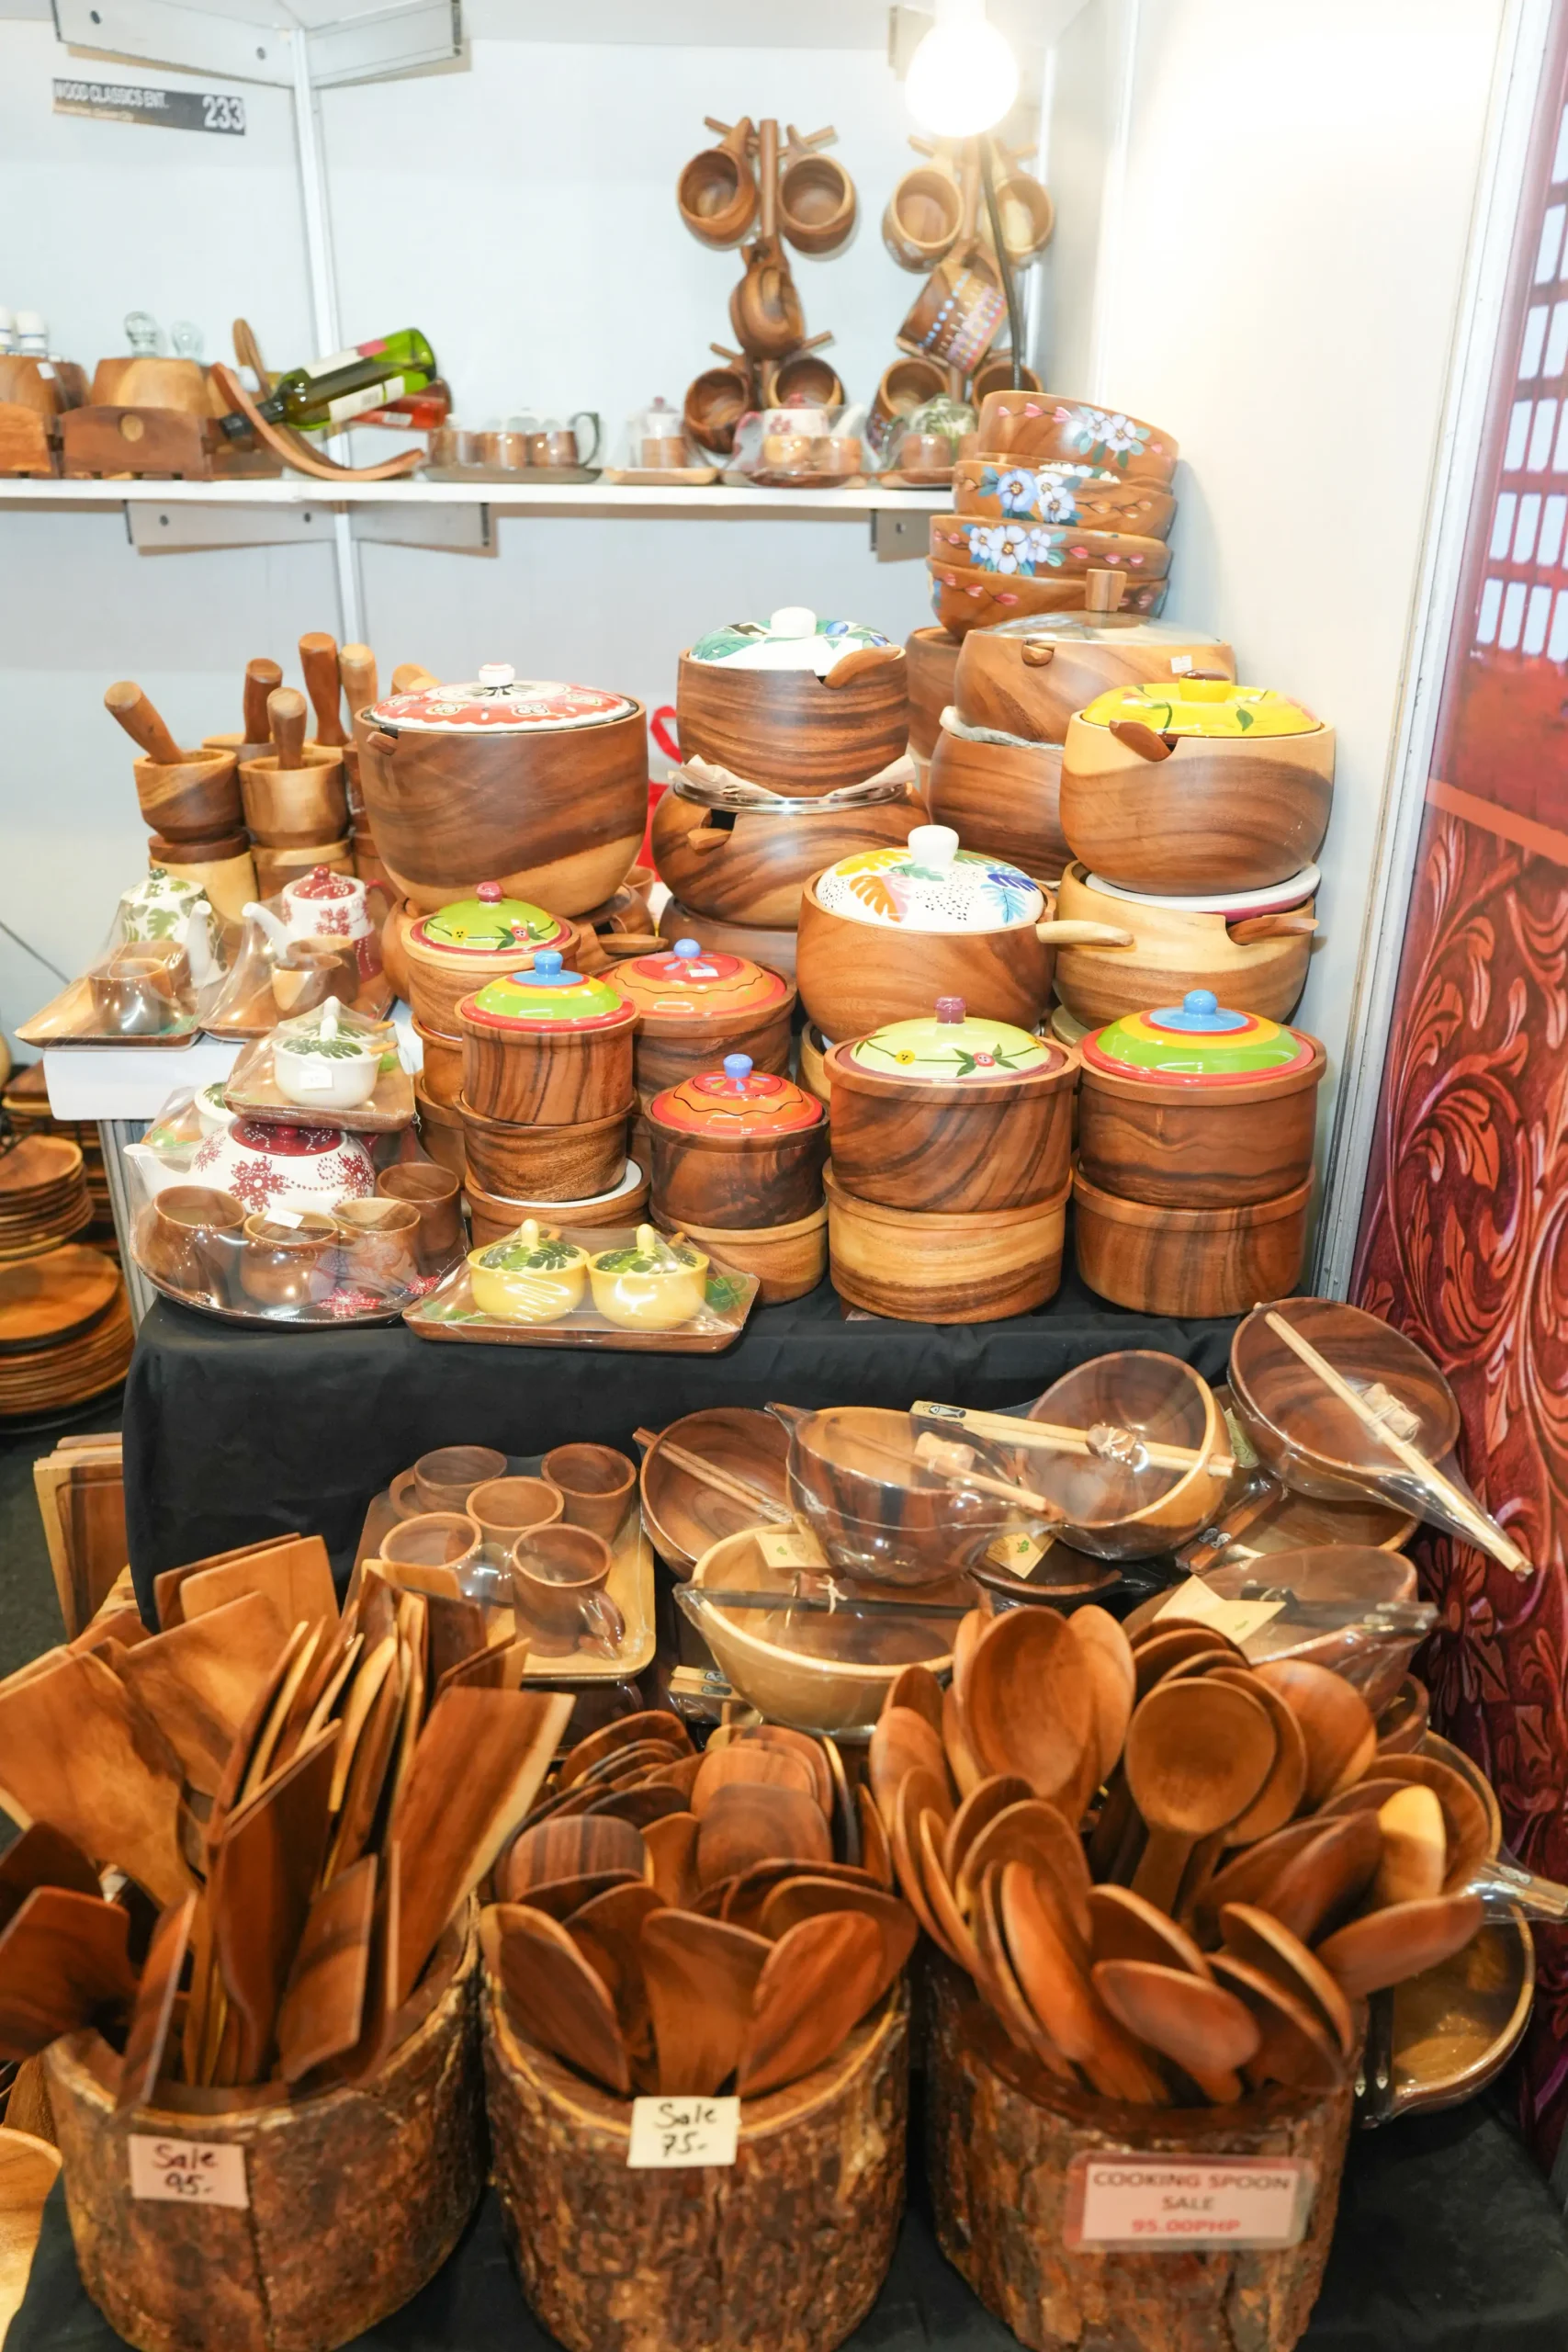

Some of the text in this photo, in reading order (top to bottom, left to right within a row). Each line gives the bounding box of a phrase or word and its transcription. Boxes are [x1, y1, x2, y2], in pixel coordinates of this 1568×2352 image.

[202, 95, 244, 130] 233
[654, 2102, 717, 2130] Sale
[152, 2143, 219, 2170] Sale
[1093, 2171, 1290, 2190] COOKING SPOON
[1161, 2195, 1215, 2211] SALE
